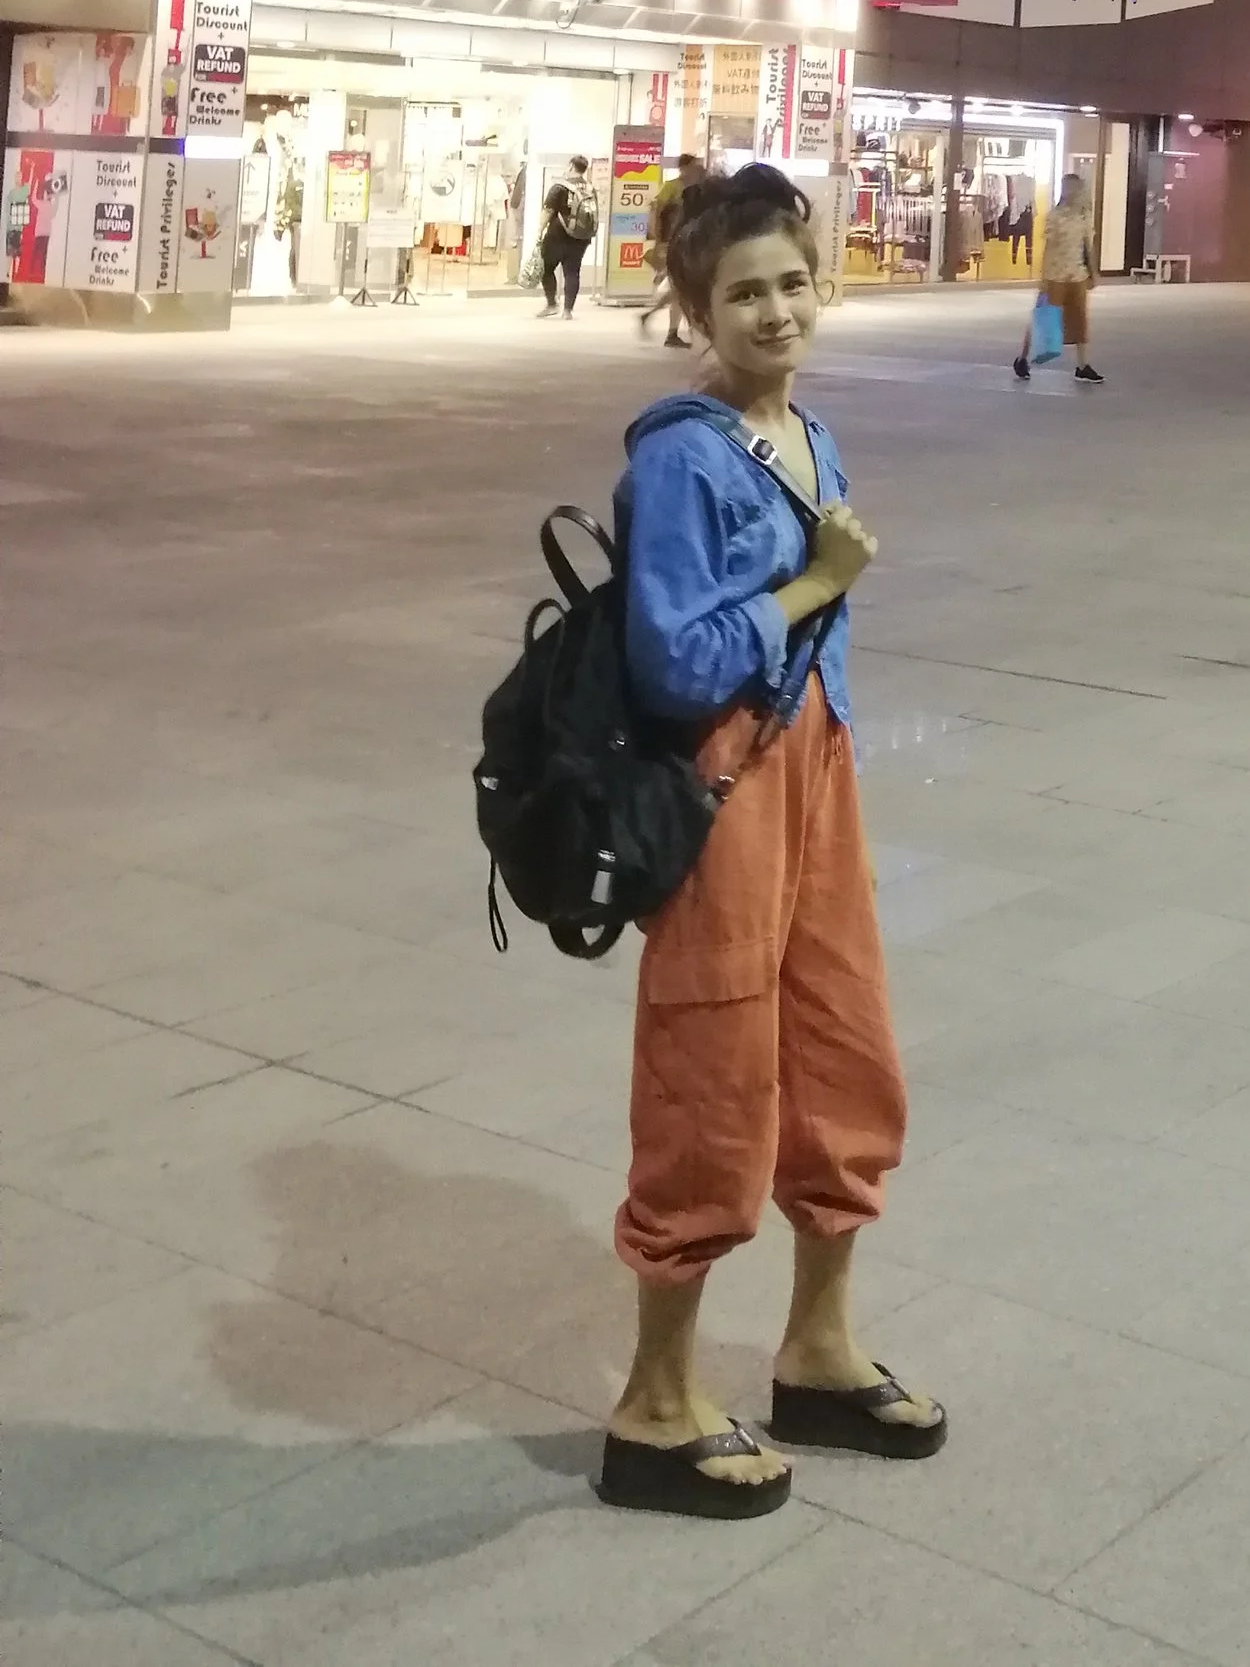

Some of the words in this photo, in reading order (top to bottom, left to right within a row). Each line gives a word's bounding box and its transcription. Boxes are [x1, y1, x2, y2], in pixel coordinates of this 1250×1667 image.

[197, 2, 240, 17] Tourist
[196, 17, 248, 31] Discount
[206, 46, 234, 60] VAT
[197, 59, 241, 74] REFUND
[802, 59, 827, 69] Tourist
[766, 47, 779, 103] Tourist
[802, 70, 832, 79] Discount
[191, 87, 228, 104] Free
[807, 92, 824, 101] VAT
[196, 105, 241, 116] Welcome
[802, 101, 829, 112] REFUND
[190, 115, 222, 126] Drinks
[851, 113, 903, 131] SPRIT
[800, 123, 820, 135] Free
[639, 153, 661, 164] SALE
[97, 160, 130, 174] Tourist
[96, 175, 136, 188] Discount
[160, 162, 177, 234] Privileges
[620, 192, 644, 207] 50
[104, 205, 126, 219] VAT
[96, 219, 131, 232] REFUND
[91, 247, 119, 263] Free
[95, 265, 129, 276] Welcome
[156, 238, 170, 289] Tourist
[89, 275, 115, 286] Drinks
